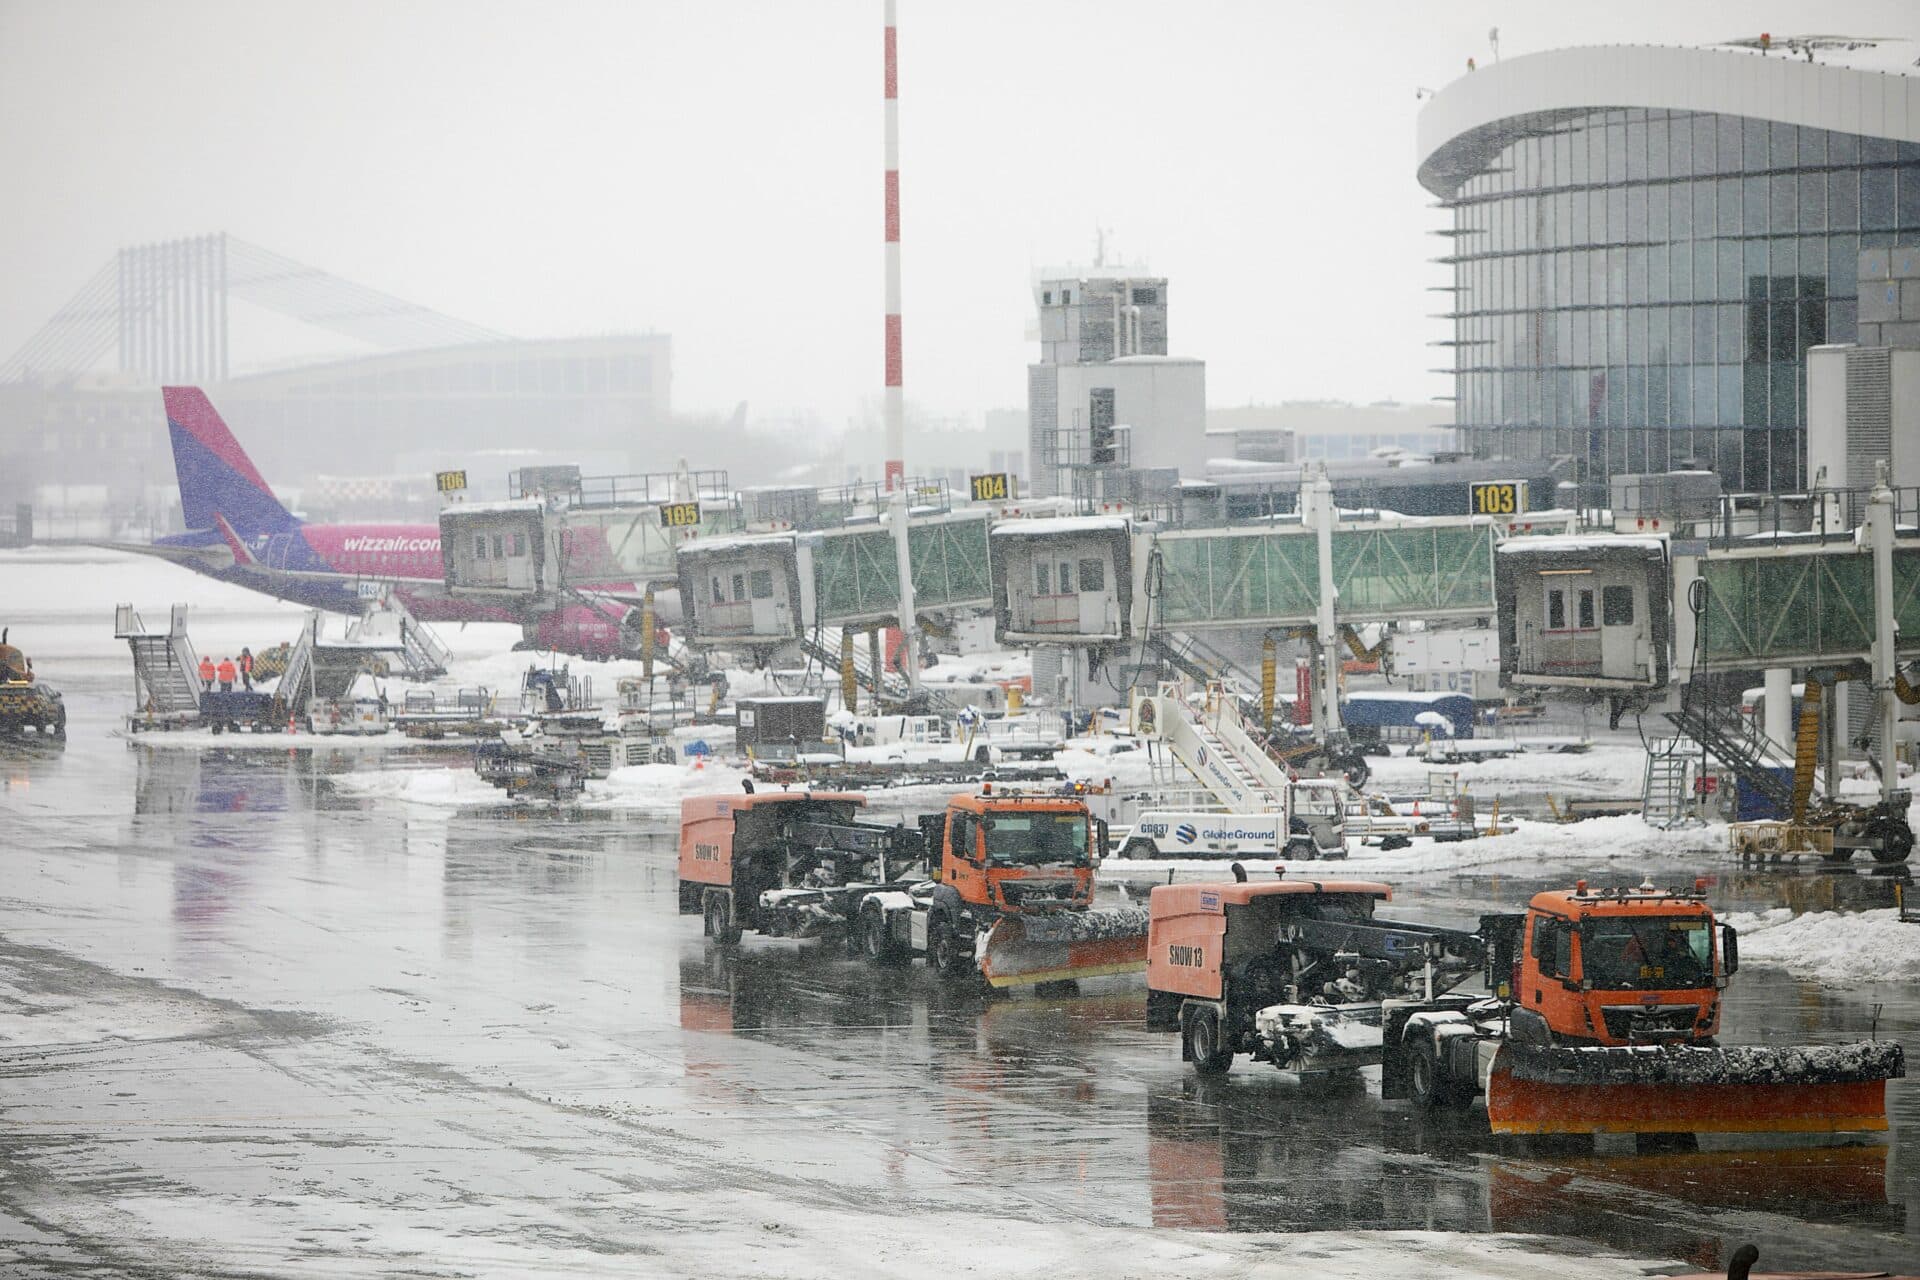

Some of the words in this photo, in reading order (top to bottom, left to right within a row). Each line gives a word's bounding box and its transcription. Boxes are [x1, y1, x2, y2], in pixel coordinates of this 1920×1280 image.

[439, 471, 465, 490] 106
[975, 475, 1004, 499] 104
[1475, 485, 1514, 513] 103
[664, 503, 698, 526] 105
[1203, 829, 1275, 840] GlobeGround
[695, 844, 712, 861] SNOW
[712, 845, 719, 862] 12
[1169, 945, 1193, 967] SNOW
[1194, 947, 1203, 968] 13
